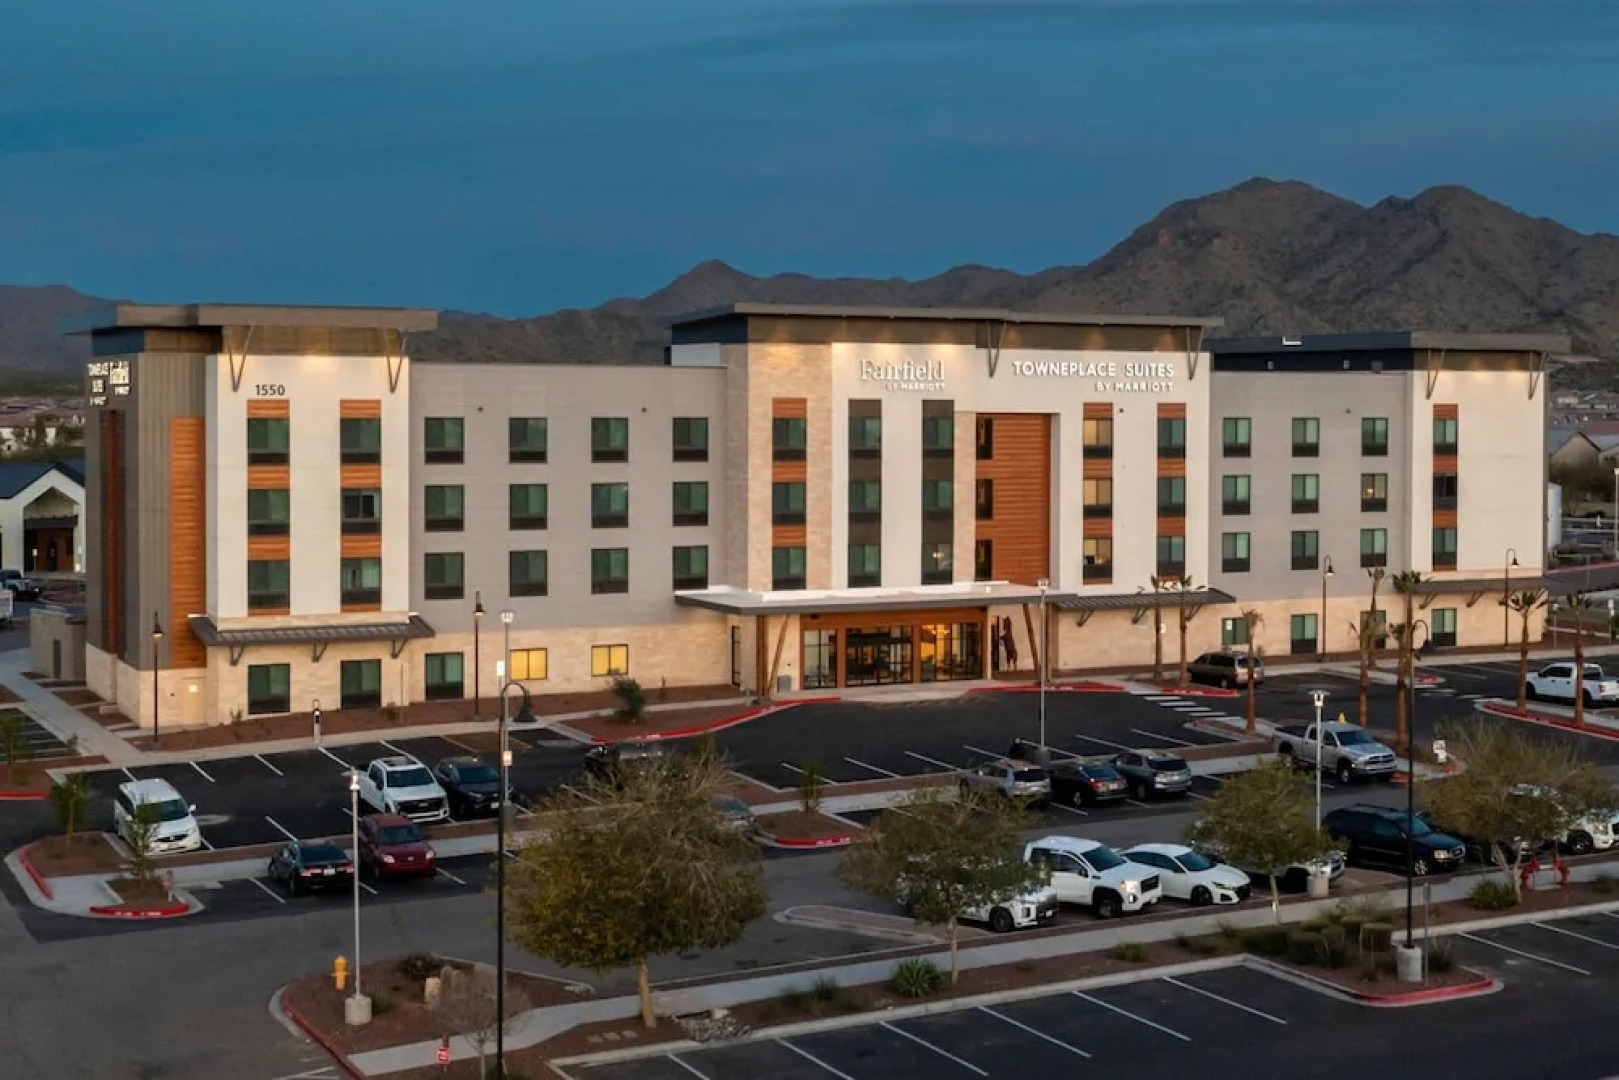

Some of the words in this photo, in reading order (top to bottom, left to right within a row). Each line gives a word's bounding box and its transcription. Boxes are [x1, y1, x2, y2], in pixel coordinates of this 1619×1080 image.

[860, 359, 945, 381] Fairfield
[1013, 361, 1116, 377] TOWNEPLACE
[1125, 363, 1175, 378] SUITES
[255, 384, 286, 396] 1550
[899, 381, 947, 392] MARRIOTT
[1096, 381, 1111, 392] BY
[1114, 382, 1174, 393] MARRIOTT
